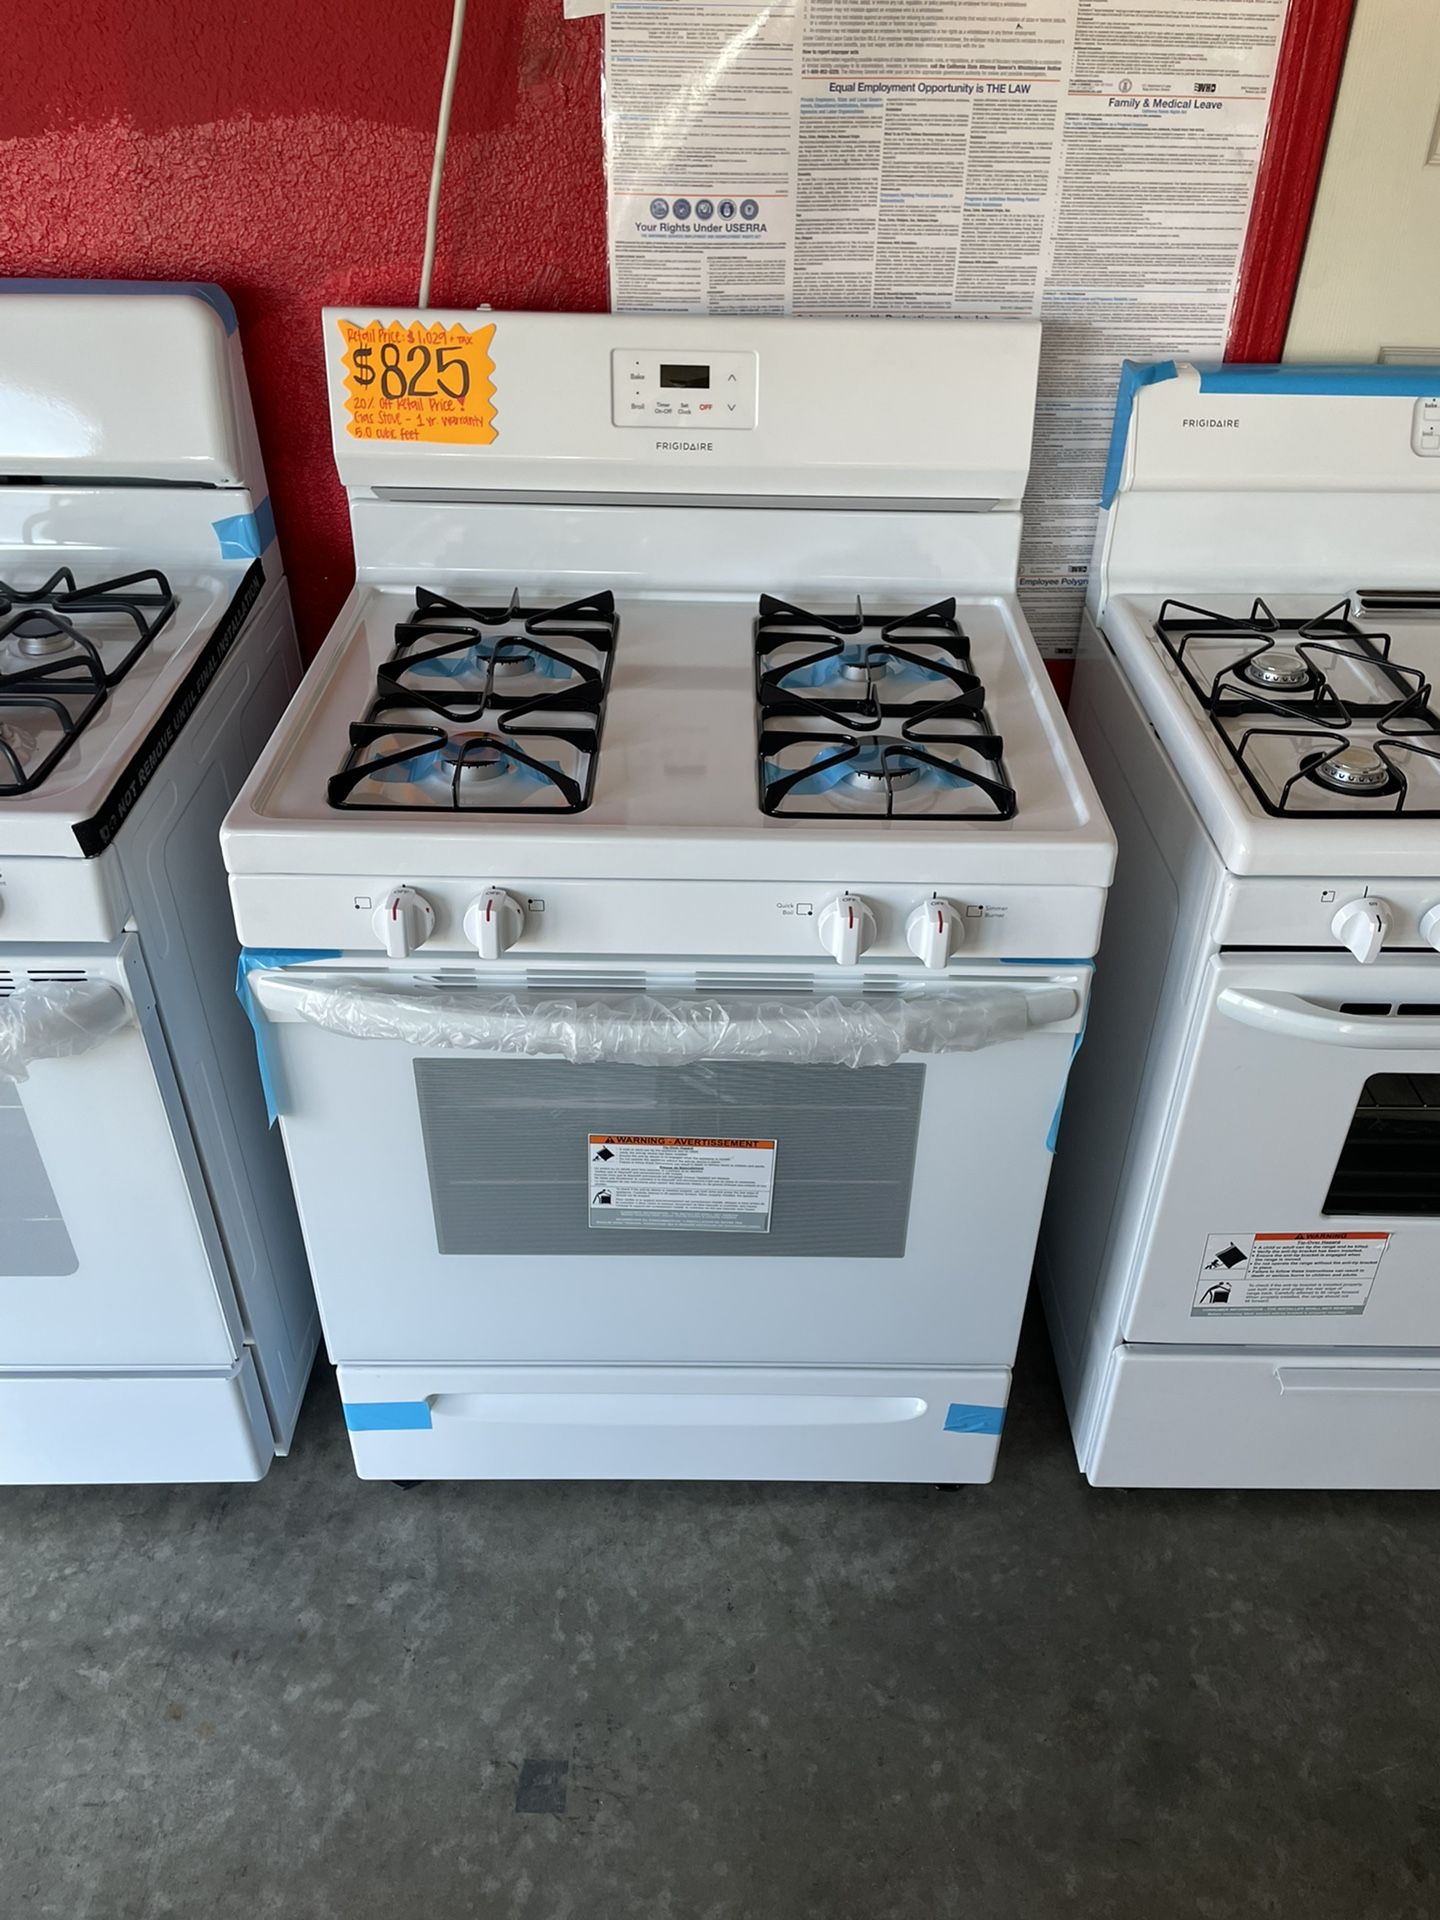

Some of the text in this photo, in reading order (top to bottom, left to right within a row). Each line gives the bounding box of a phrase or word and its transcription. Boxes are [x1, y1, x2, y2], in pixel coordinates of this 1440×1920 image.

[829, 82, 1031, 95] Equal Employment Opportunity is THE LAW
[1108, 97, 1223, 109] Family & Medical Leave
[635, 222, 767, 233] Your Rights Under USERRA
[347, 329, 375, 342] Retail
[353, 342, 470, 400] $825
[353, 397, 375, 410] 20%
[397, 397, 424, 411] Retail
[354, 411, 374, 424] Gas
[378, 410, 403, 425] Stove
[1182, 419, 1240, 428] FRIGIDAIRE
[355, 427, 372, 438] 5.0
[400, 428, 420, 440] feet
[655, 442, 713, 451] FRIGIDAIRE
[1020, 578, 1059, 586] Employee
[117, 780, 138, 816] NOT
[138, 727, 173, 786] REMOVE
[173, 692, 197, 727] UNTIL
[196, 655, 218, 694] FINAL
[217, 575, 260, 656] INSTALLATION
[616, 1136, 665, 1145] WARNING
[673, 1138, 759, 1148] AVERTISSEMENT
